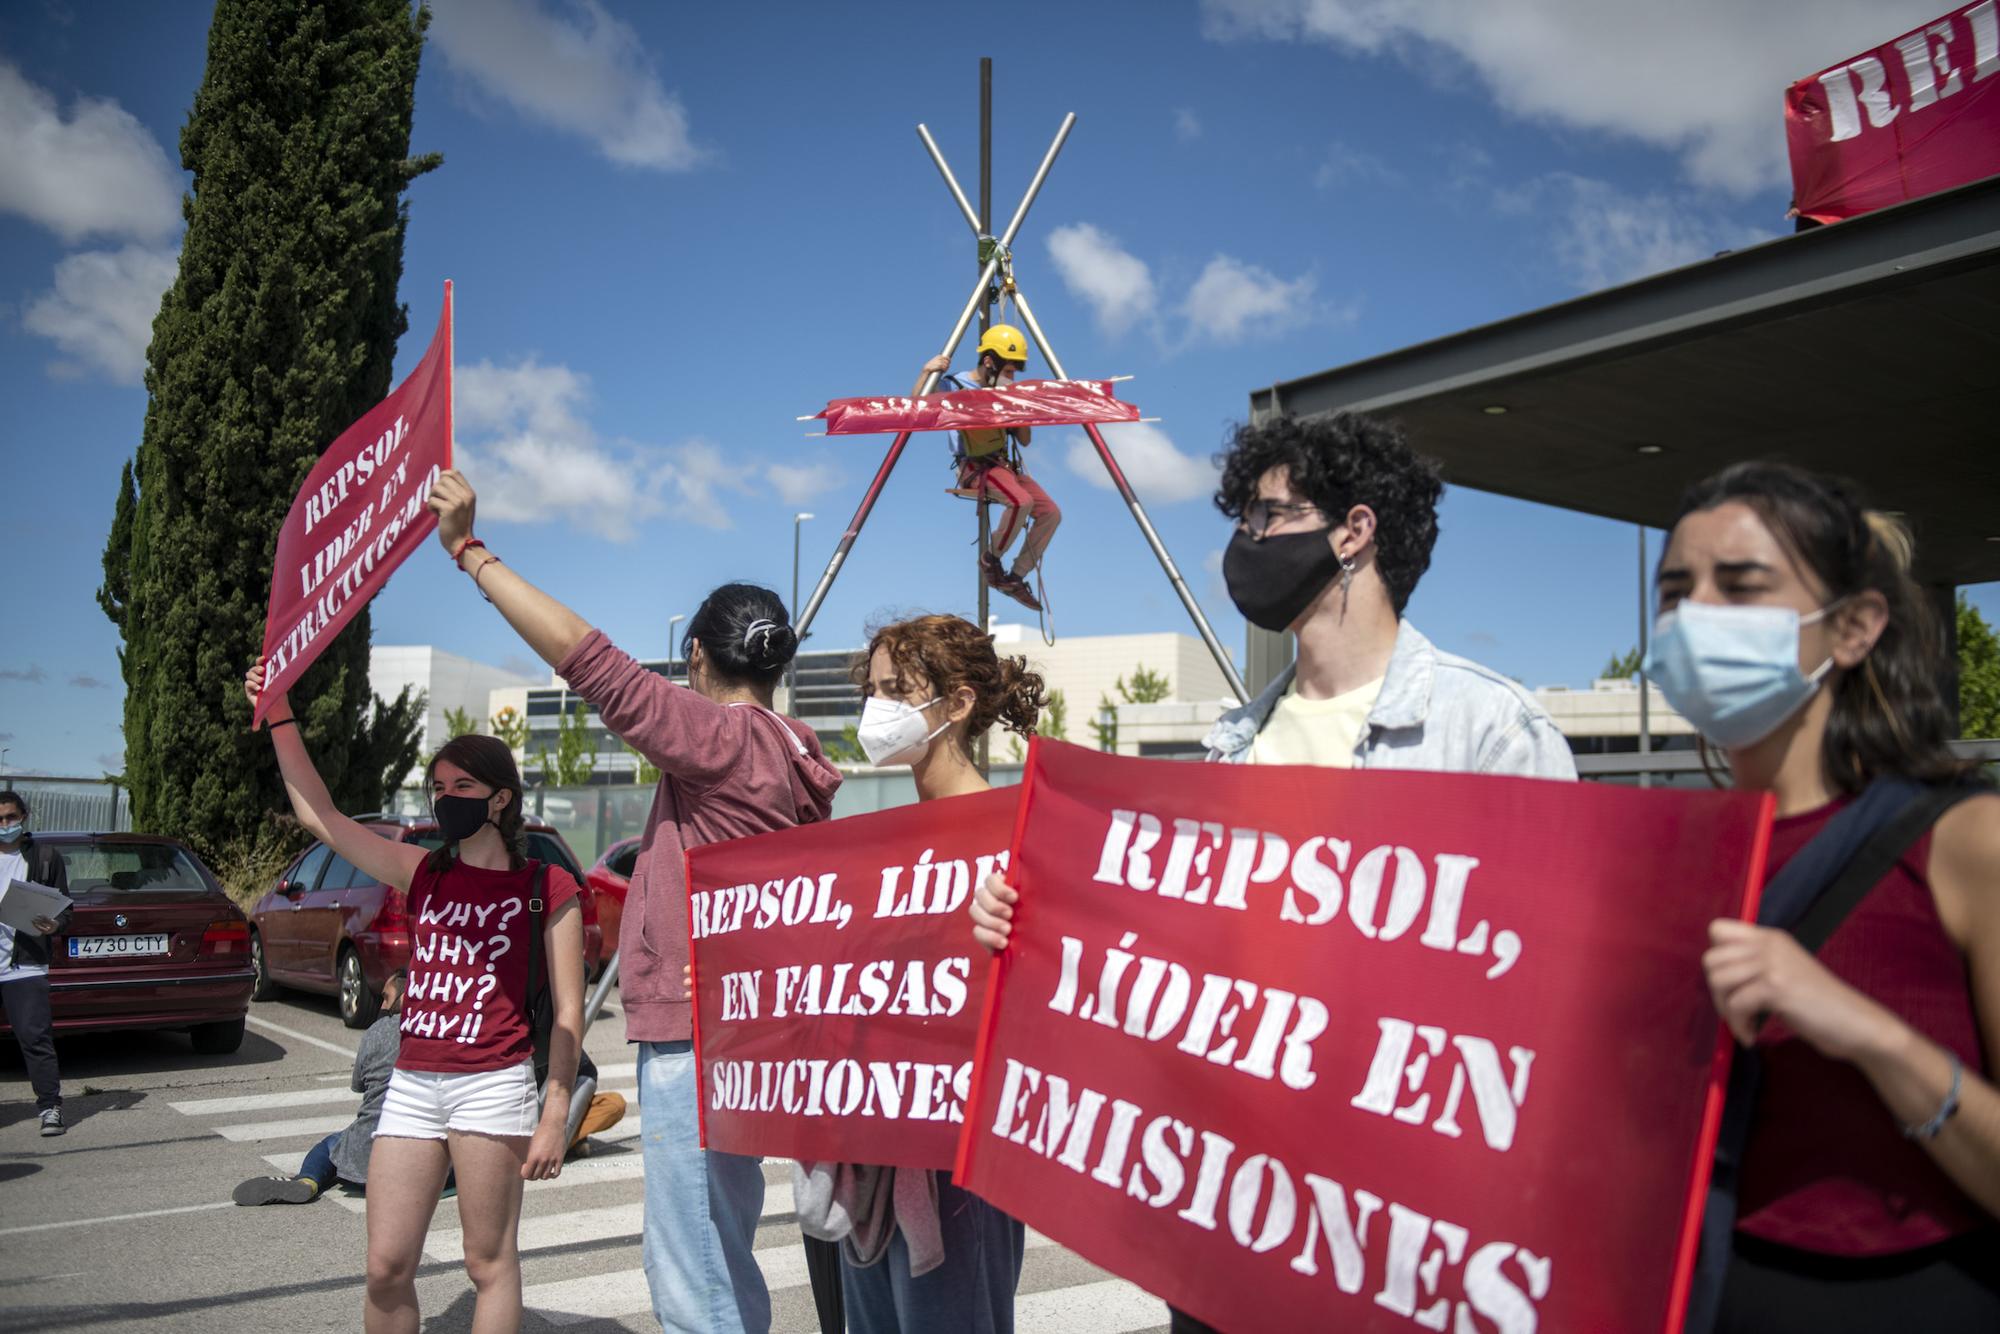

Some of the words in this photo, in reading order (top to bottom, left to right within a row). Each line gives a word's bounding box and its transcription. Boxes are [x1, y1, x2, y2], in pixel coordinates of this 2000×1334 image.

[379, 451, 411, 514] EN
[263, 464, 440, 691] EXTRACTIVISMO
[419, 894, 522, 930] WHY?
[691, 873, 852, 940] REPSOL,
[1093, 809, 1523, 979] REPSOL,
[82, 938, 127, 953] 4730
[134, 936, 163, 951] CTY
[415, 932, 511, 972] WHY?
[408, 971, 496, 1010] WHY?
[720, 969, 763, 1021] EN
[772, 957, 970, 1018] FALSAS
[400, 1007, 483, 1044] WHY!!
[1048, 931, 1329, 1090] LÍDER
[1351, 1017, 1536, 1151] EN
[711, 1058, 974, 1123] SOLUCIONES
[991, 1058, 1552, 1334] EMISIONES
